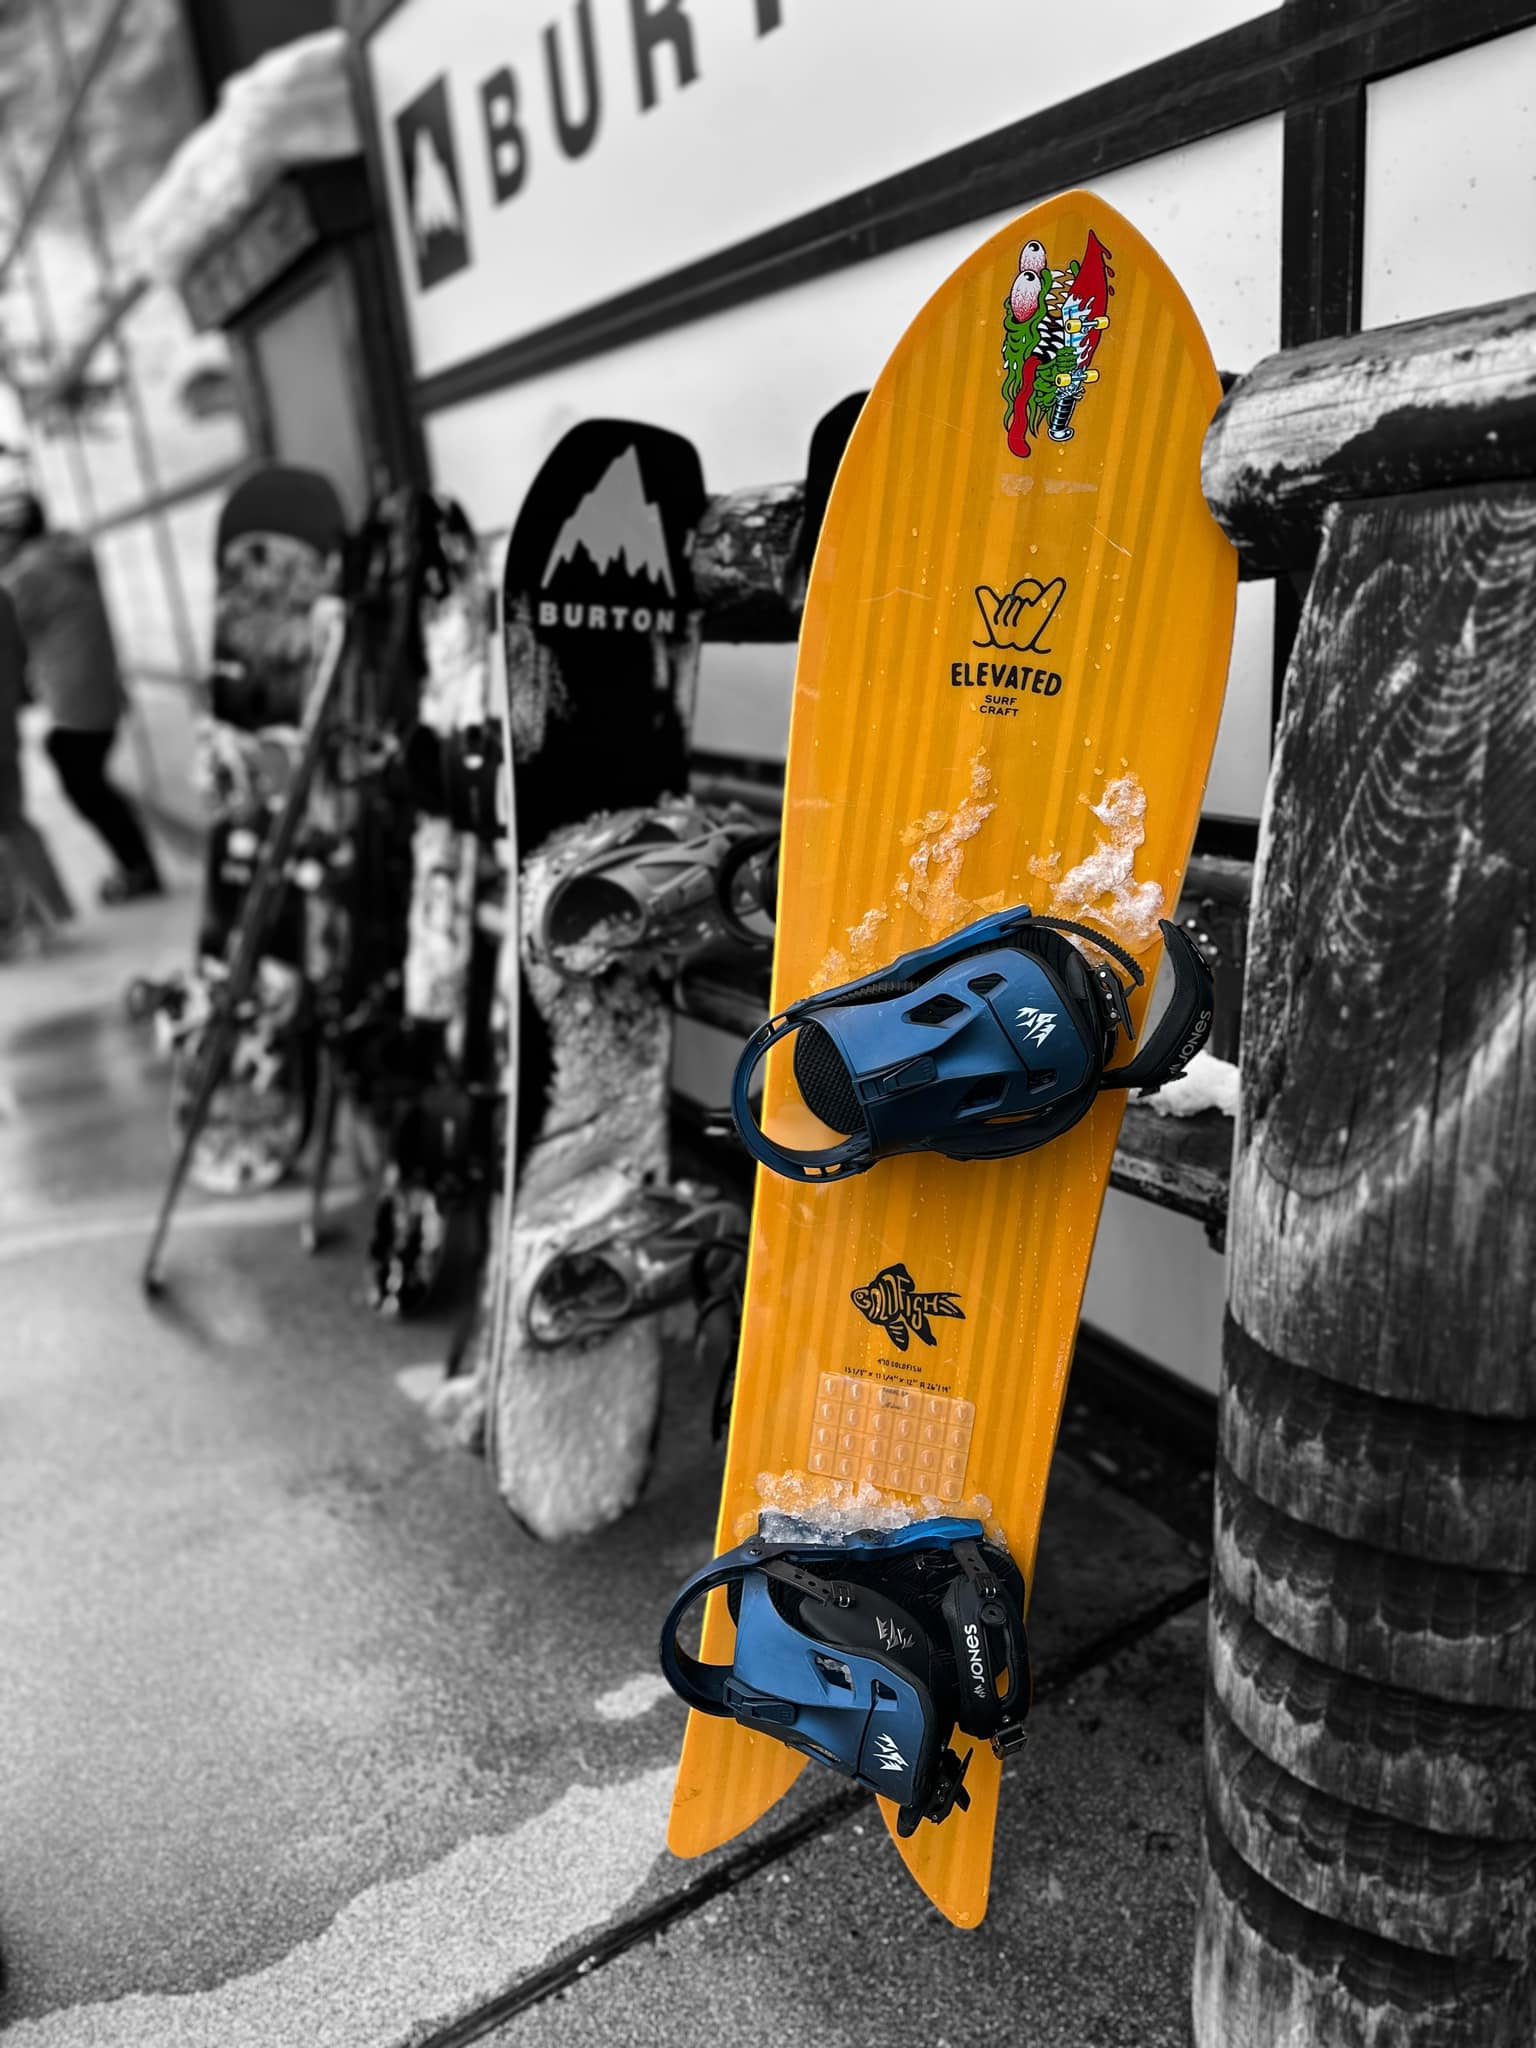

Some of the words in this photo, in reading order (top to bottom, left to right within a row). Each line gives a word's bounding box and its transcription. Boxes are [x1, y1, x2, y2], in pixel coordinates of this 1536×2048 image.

[477, 0, 784, 210] BUR
[539, 602, 676, 632] BURTON
[951, 662, 1062, 696] ELEVATED
[979, 705, 1019, 717] CRAFT
[985, 694, 1018, 706] SURF
